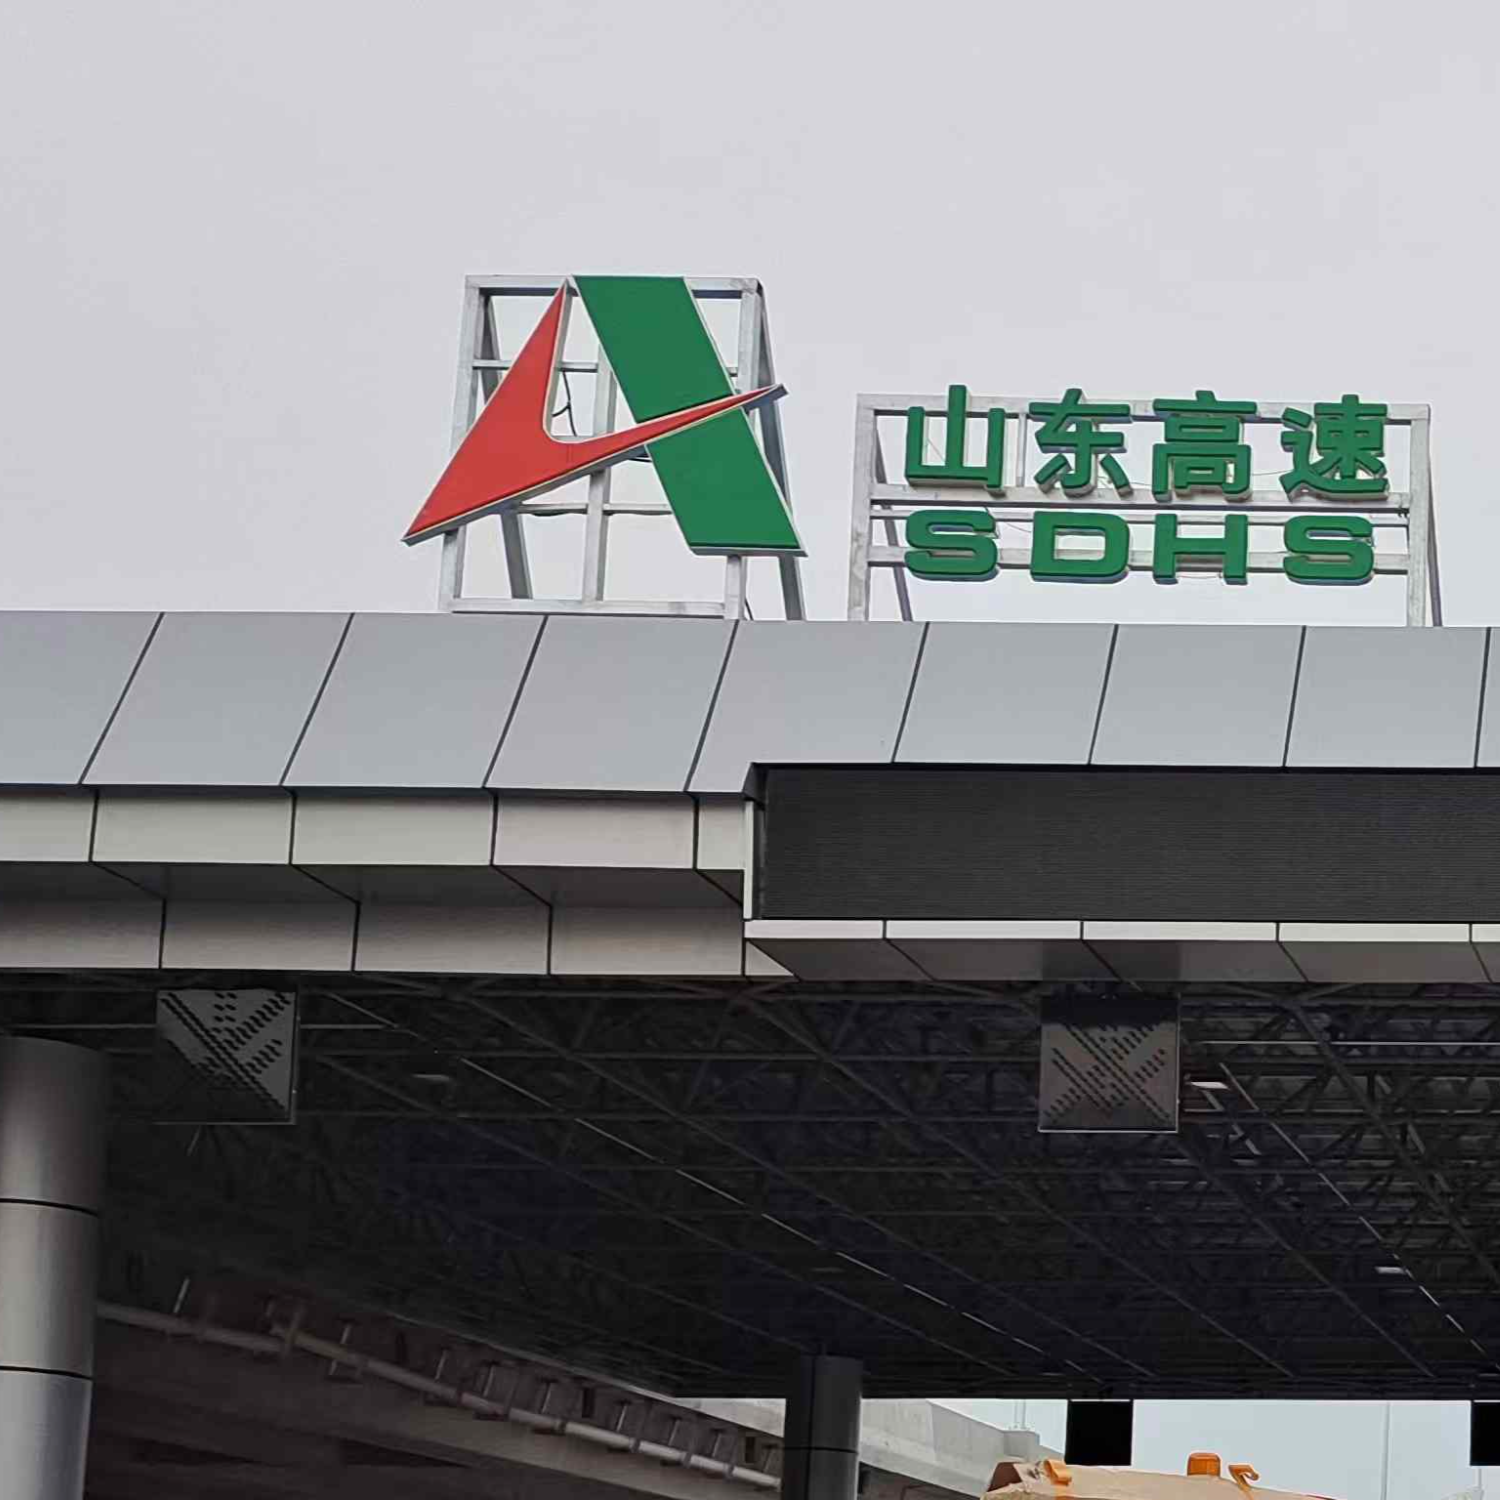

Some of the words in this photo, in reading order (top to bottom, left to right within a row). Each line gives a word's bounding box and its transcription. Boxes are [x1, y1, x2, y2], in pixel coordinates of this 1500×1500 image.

[905, 385, 1391, 499] 山东高速
[903, 509, 1377, 584] SDHS
